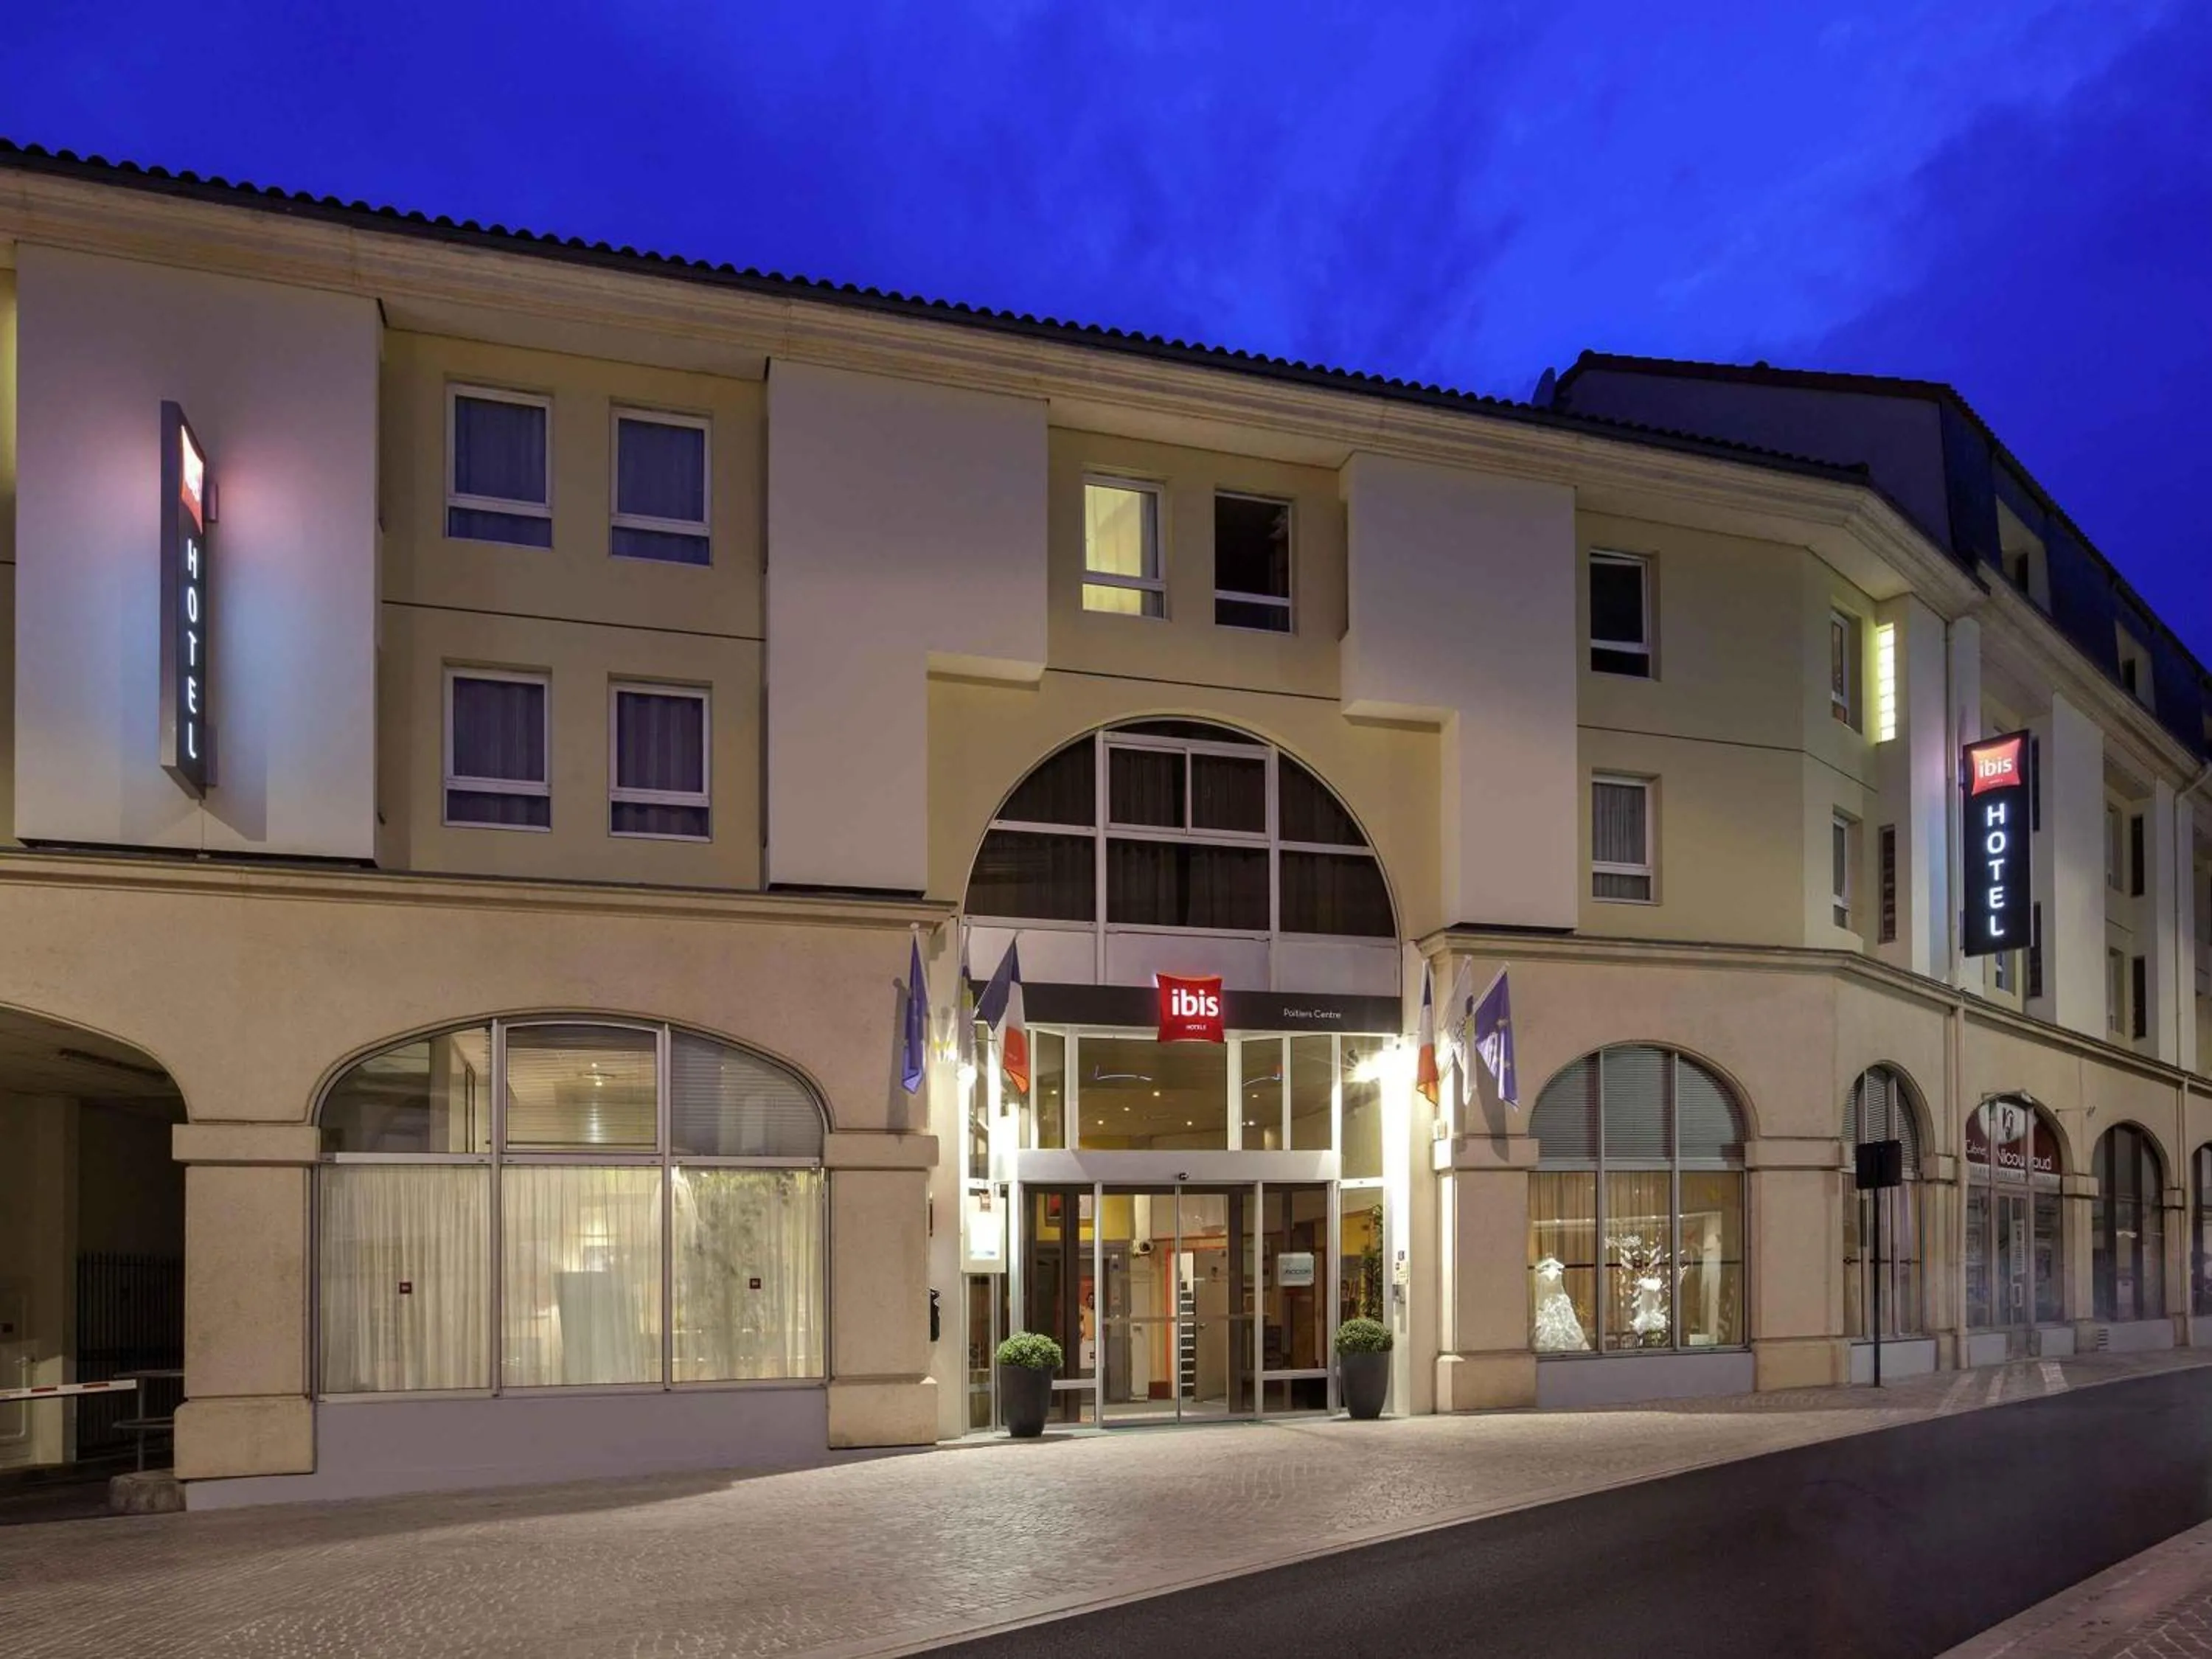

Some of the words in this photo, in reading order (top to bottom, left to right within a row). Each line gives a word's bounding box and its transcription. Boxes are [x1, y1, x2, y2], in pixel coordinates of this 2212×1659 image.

[187, 538, 198, 759] HOTEL
[1978, 757, 2013, 779] ibis
[1986, 802, 2006, 936] HOTEL
[1171, 988, 1219, 1017] ibis
